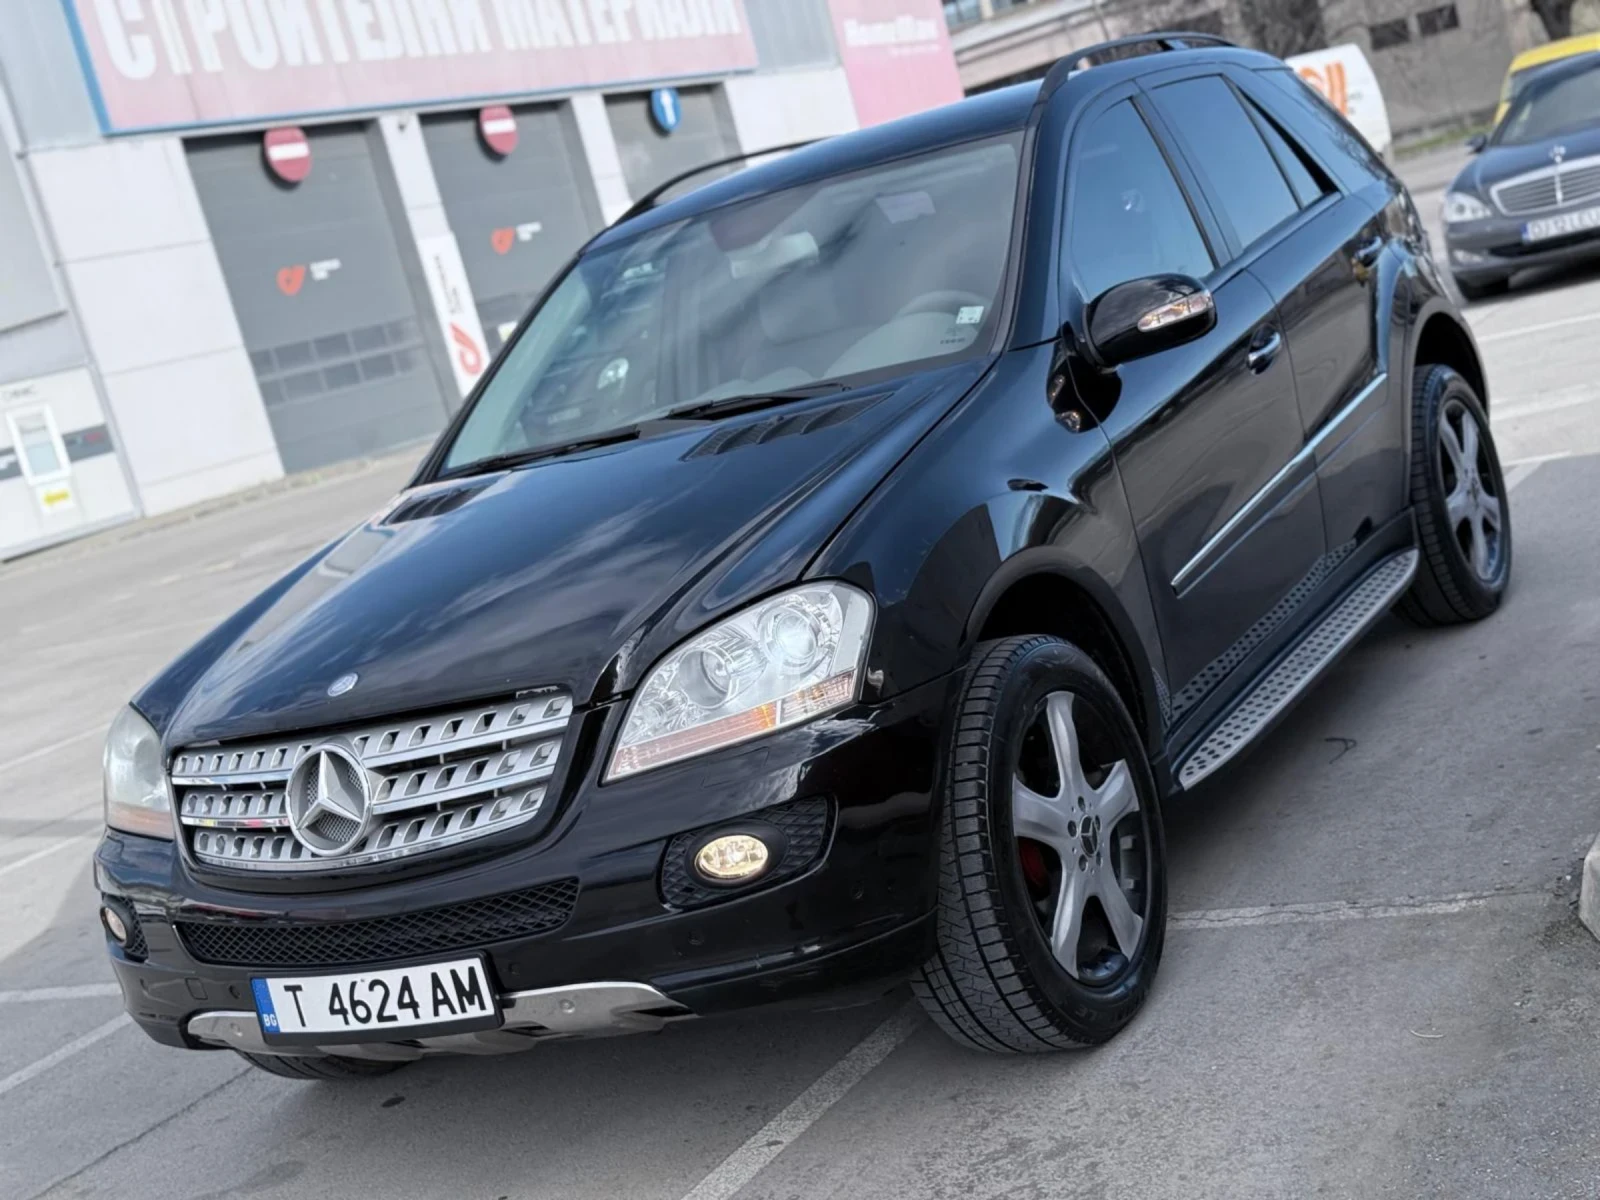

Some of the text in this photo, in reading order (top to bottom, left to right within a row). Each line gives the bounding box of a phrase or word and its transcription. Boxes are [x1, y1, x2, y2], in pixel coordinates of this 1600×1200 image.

[283, 965, 487, 1028] T 4624 AM
[263, 1013, 277, 1027] BG
